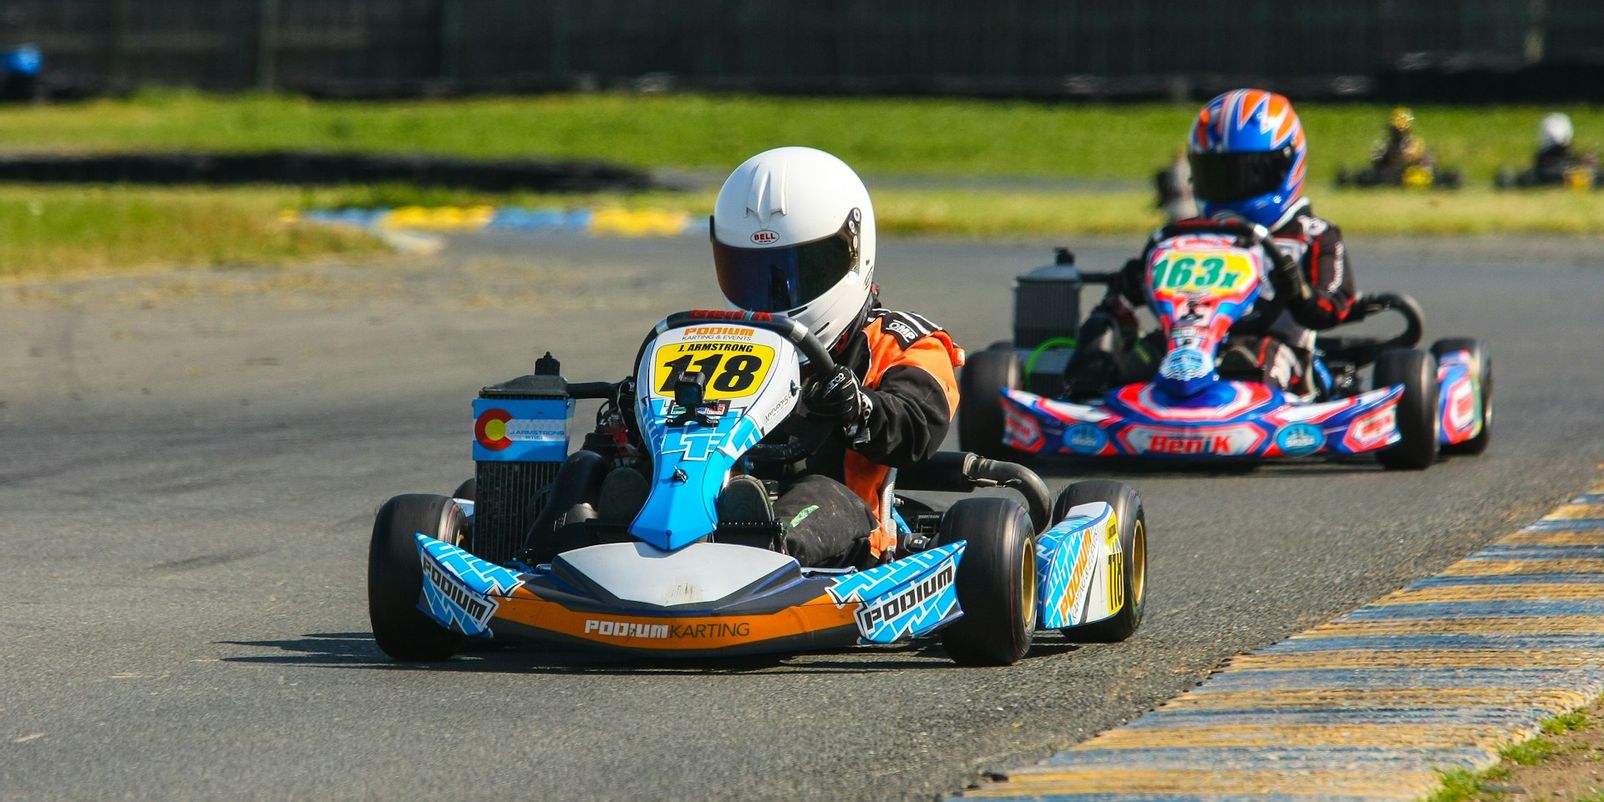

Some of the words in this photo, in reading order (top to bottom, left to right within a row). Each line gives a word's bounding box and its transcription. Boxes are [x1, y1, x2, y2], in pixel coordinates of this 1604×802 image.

[754, 232, 776, 240] BELL
[684, 327, 754, 337] PODIUM
[687, 343, 753, 353] ARMSTRONG
[888, 322, 916, 340] OMP
[659, 353, 762, 392] 118
[422, 555, 489, 622] PODIUM
[1060, 528, 1092, 624] PODIUM
[1108, 552, 1123, 611] 118
[864, 564, 952, 630] PODIUM
